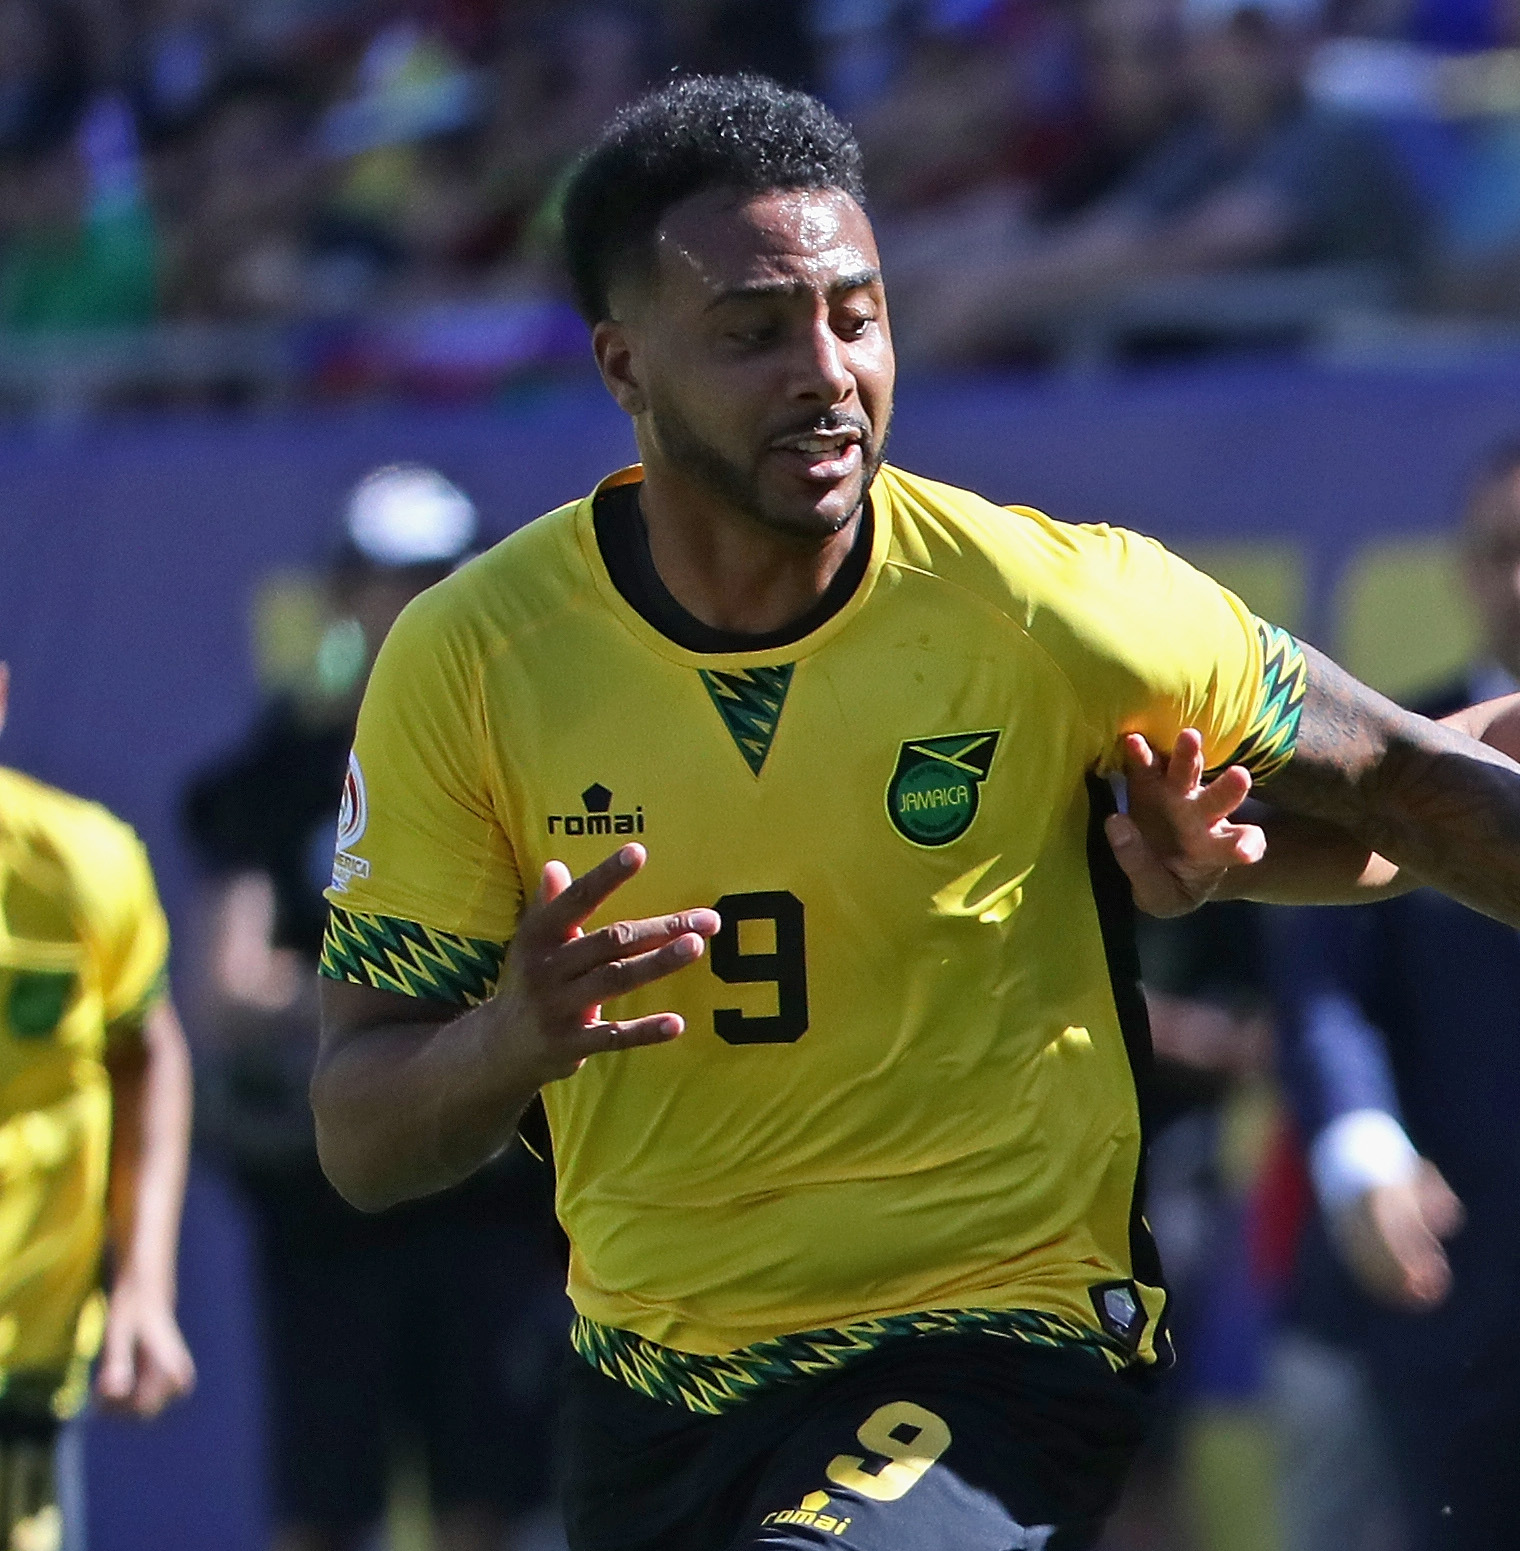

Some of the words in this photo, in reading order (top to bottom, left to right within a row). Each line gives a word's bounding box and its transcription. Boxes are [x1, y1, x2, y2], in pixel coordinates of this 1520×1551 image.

[899, 784, 969, 813] JAMAICA
[547, 805, 645, 835] romai
[709, 890, 809, 1046] 9
[825, 1400, 952, 1502] 9
[760, 1509, 852, 1537] romai
